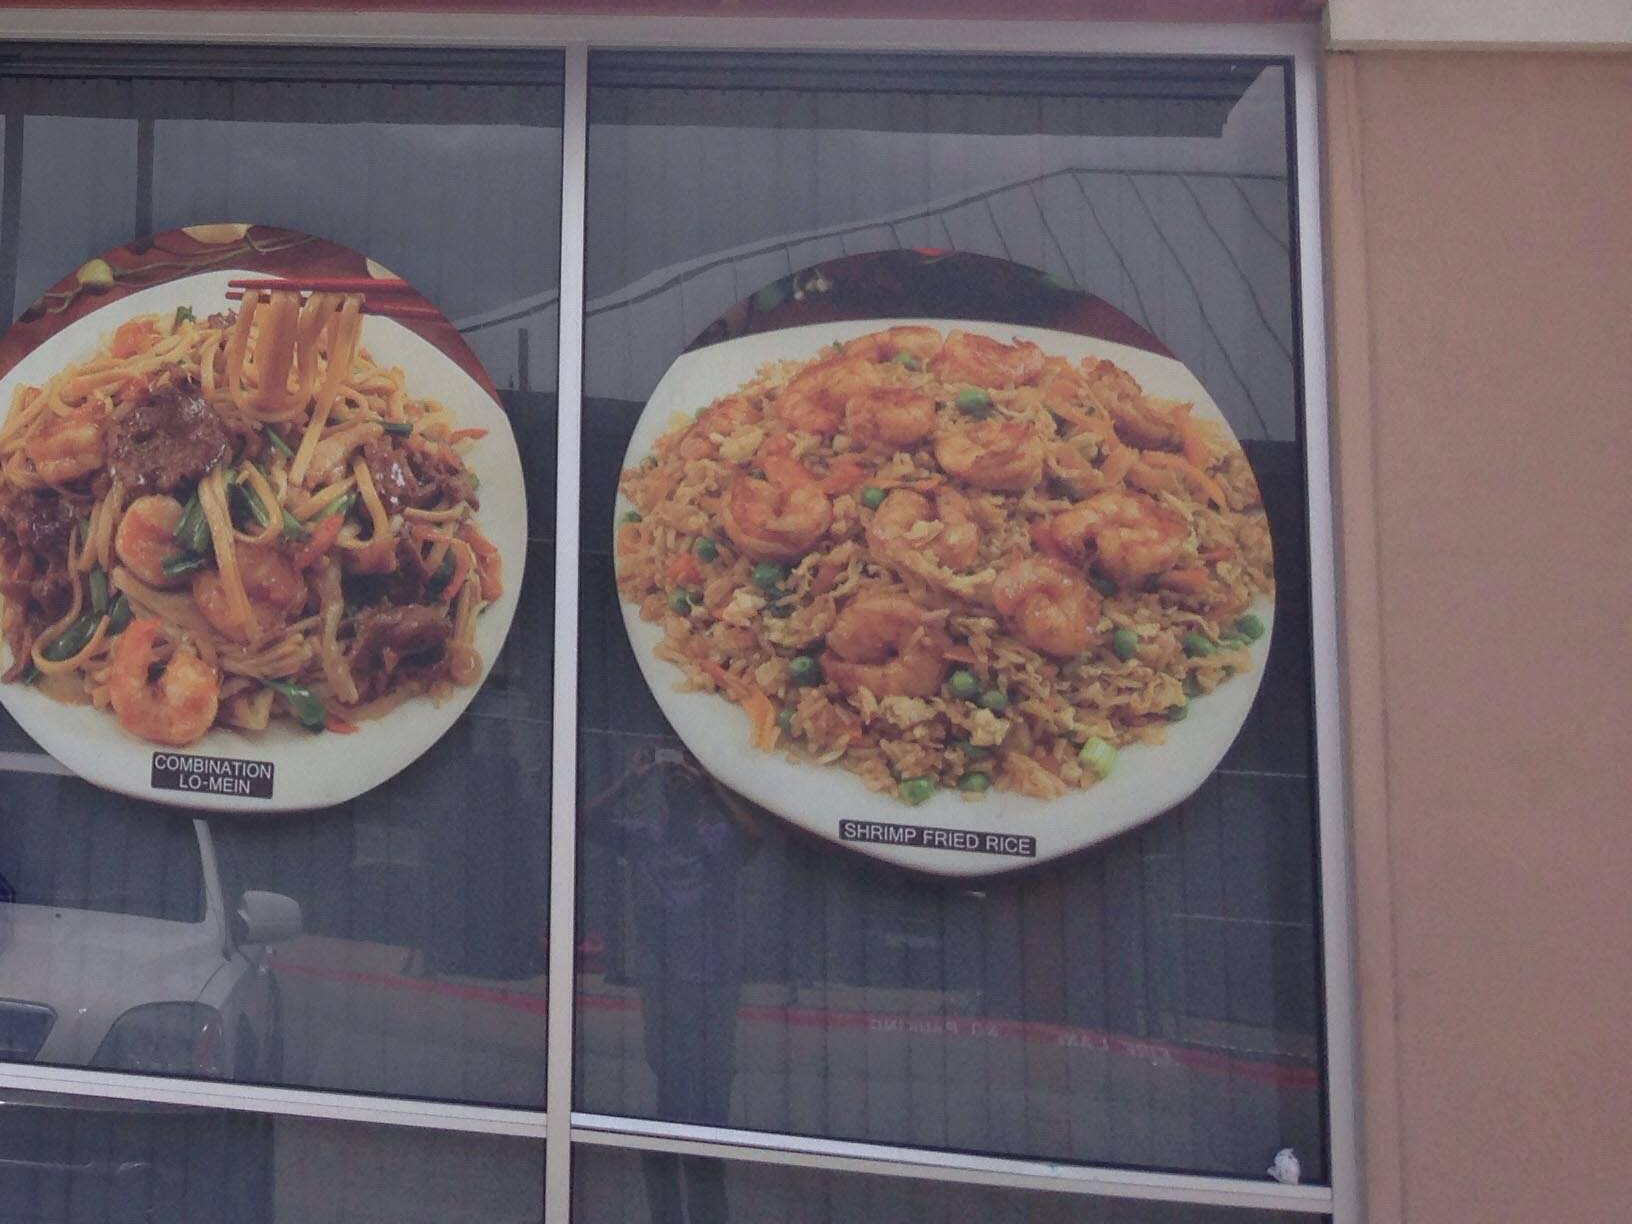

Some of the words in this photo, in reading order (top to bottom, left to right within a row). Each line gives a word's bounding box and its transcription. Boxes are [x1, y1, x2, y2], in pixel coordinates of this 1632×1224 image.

[154, 754, 273, 780] COMBINATION
[179, 773, 251, 795] LO-MEIN
[844, 821, 917, 843] SHRIMP
[922, 829, 980, 850] FRIED
[985, 835, 1031, 855] RICE
